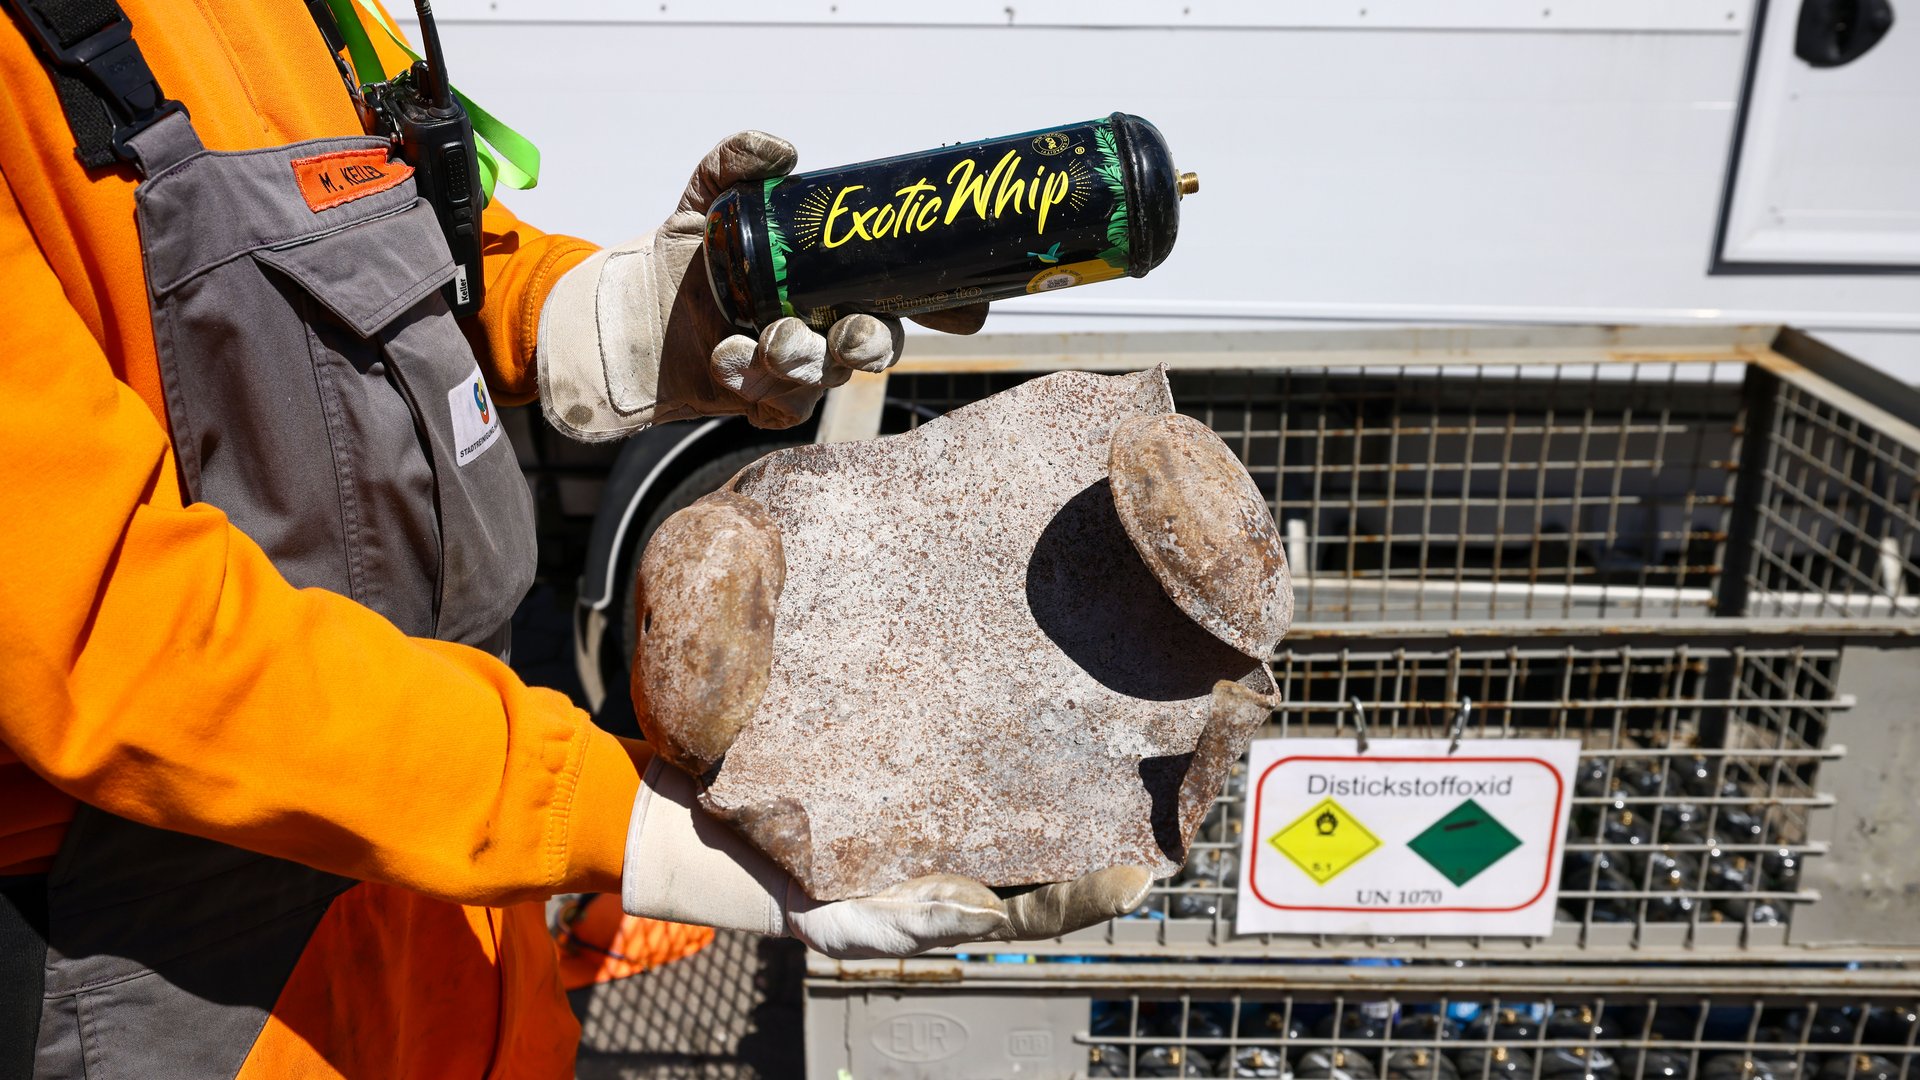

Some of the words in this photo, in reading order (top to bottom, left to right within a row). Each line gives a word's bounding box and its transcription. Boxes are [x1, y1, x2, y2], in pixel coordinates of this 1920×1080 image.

[319, 172, 344, 193] M.
[823, 177, 943, 248] Exotic
[944, 149, 1069, 235] Whip
[460, 279, 469, 302] Keller
[1307, 774, 1513, 797] Distickstoffoxid
[1356, 889, 1391, 905] UN
[1399, 889, 1442, 905] 1070
[890, 1021, 949, 1053] EUR
